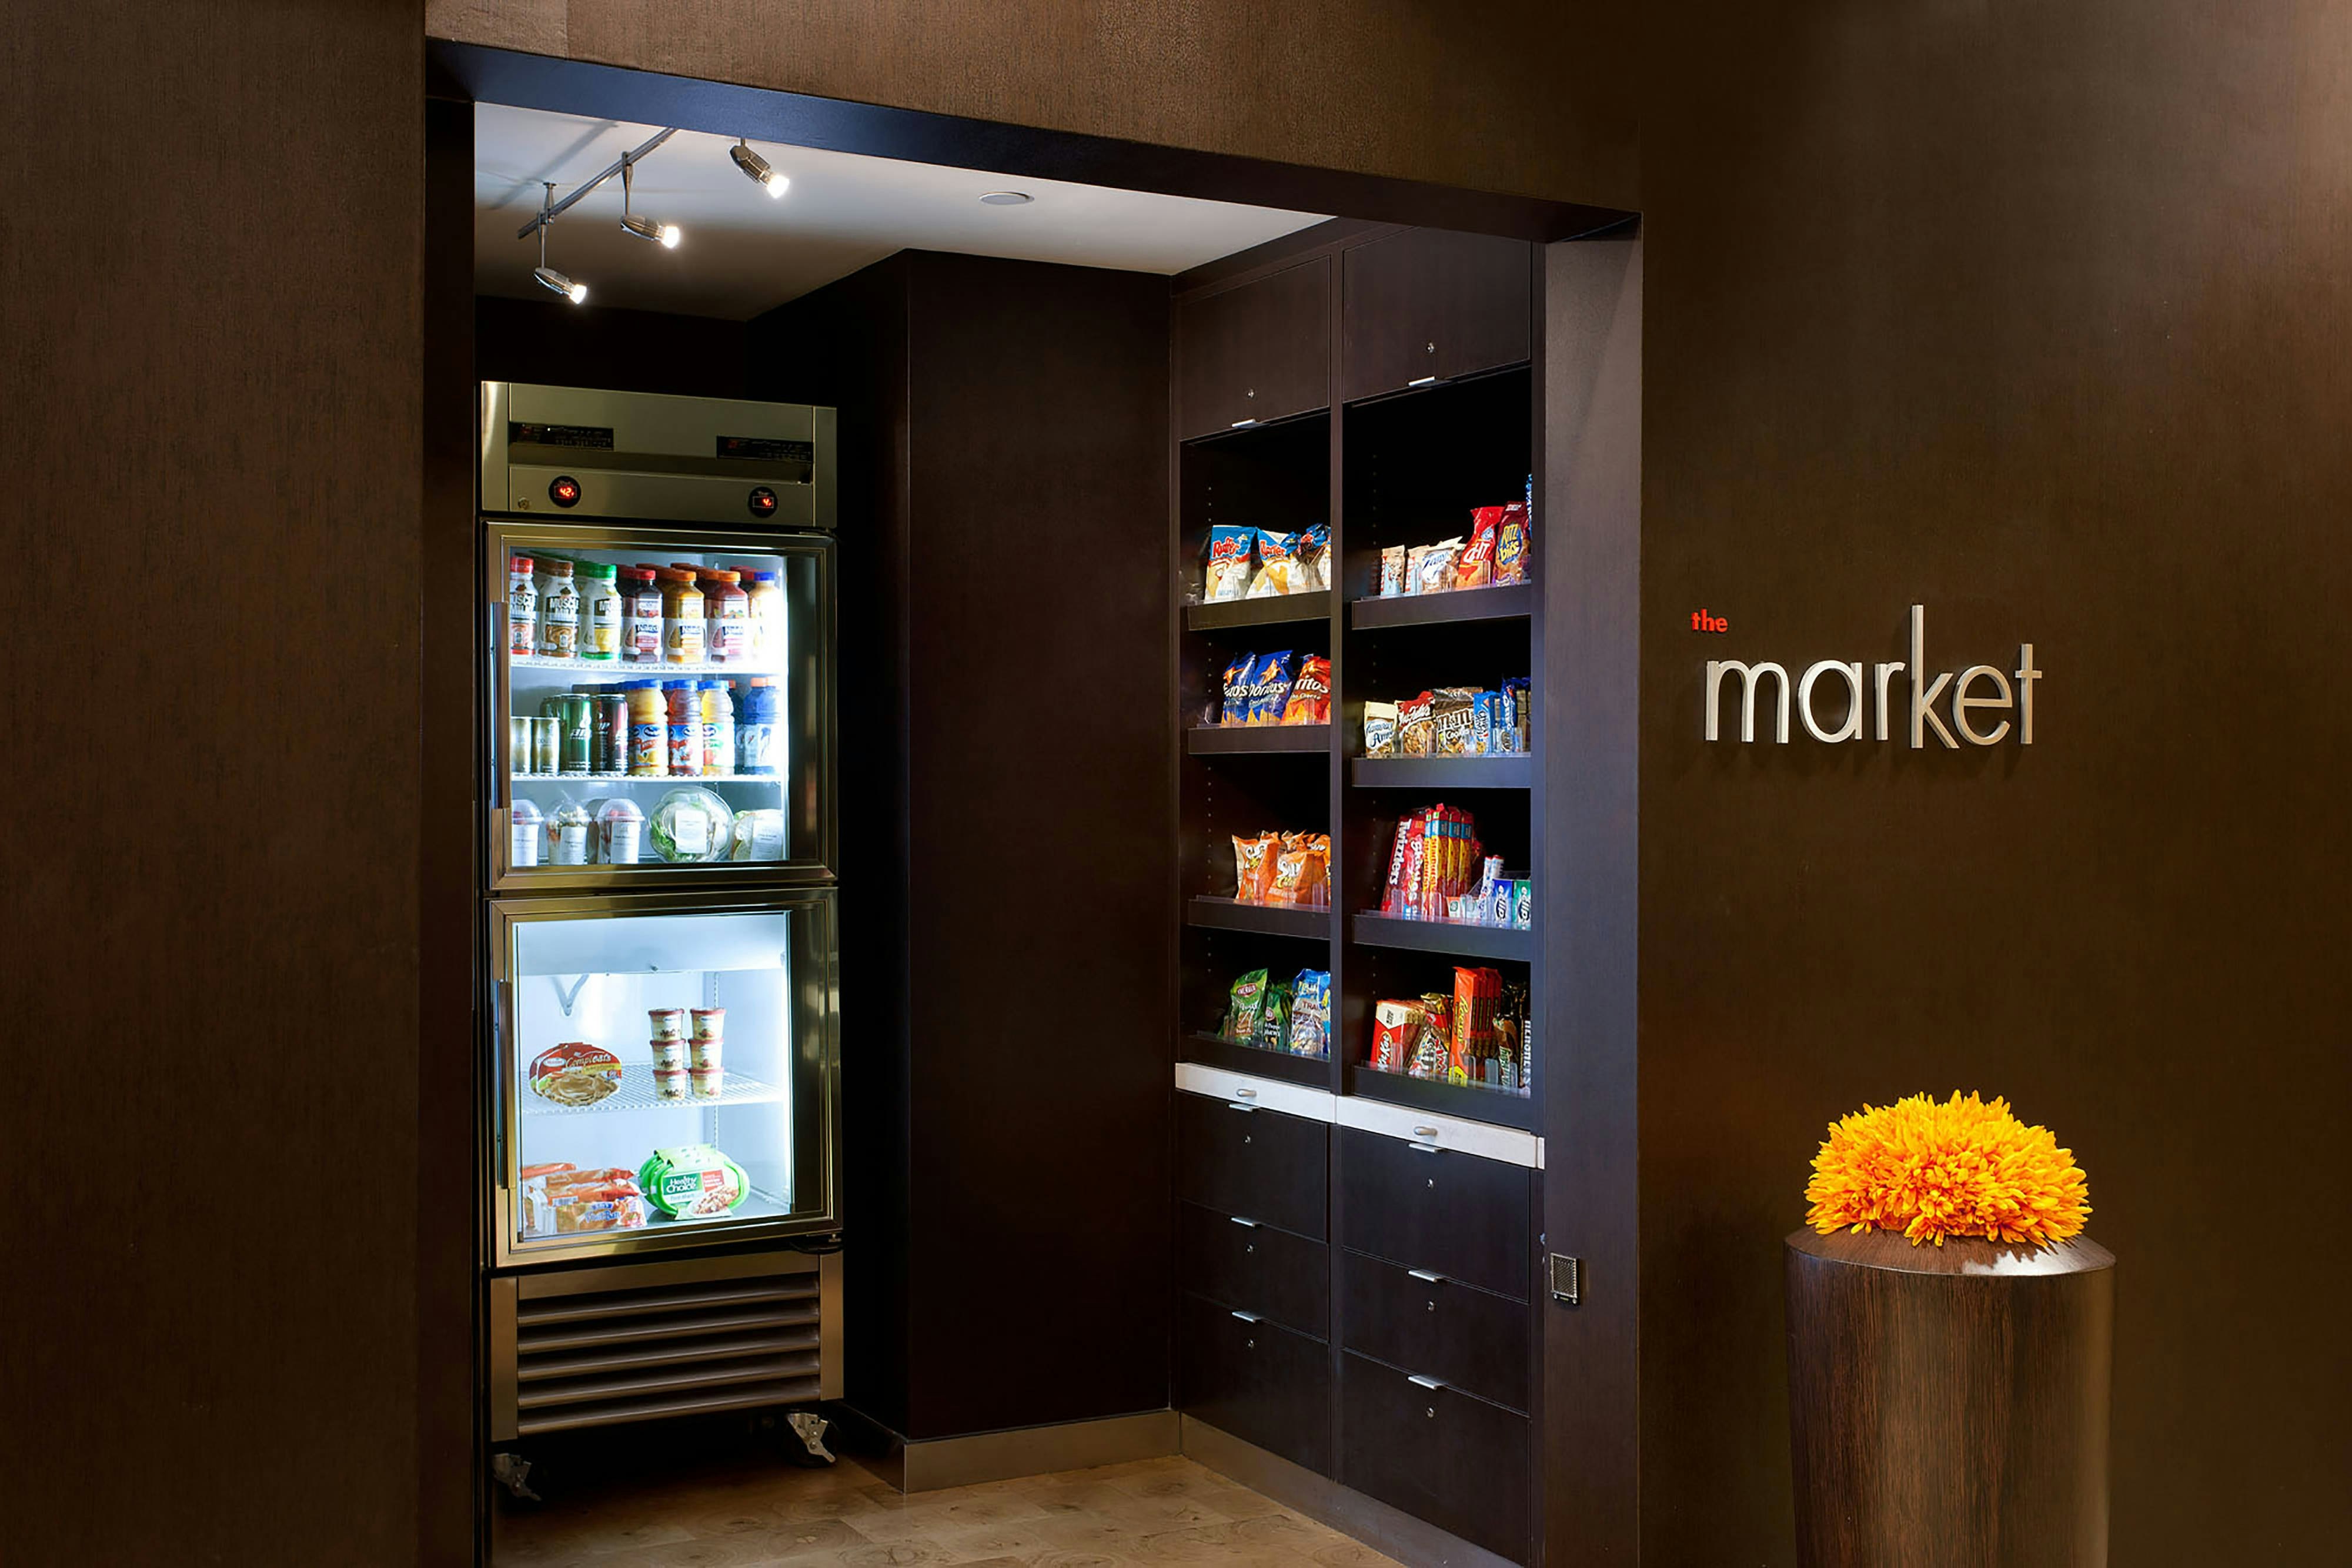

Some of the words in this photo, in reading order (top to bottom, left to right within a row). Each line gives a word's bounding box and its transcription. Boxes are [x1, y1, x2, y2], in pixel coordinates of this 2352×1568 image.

[1691, 609, 1728, 633] the
[1705, 605, 2042, 748] market
[1389, 818, 1412, 885] Twizzlers
[666, 1183, 697, 1193] Choice
[670, 1176, 697, 1186] Healthy
